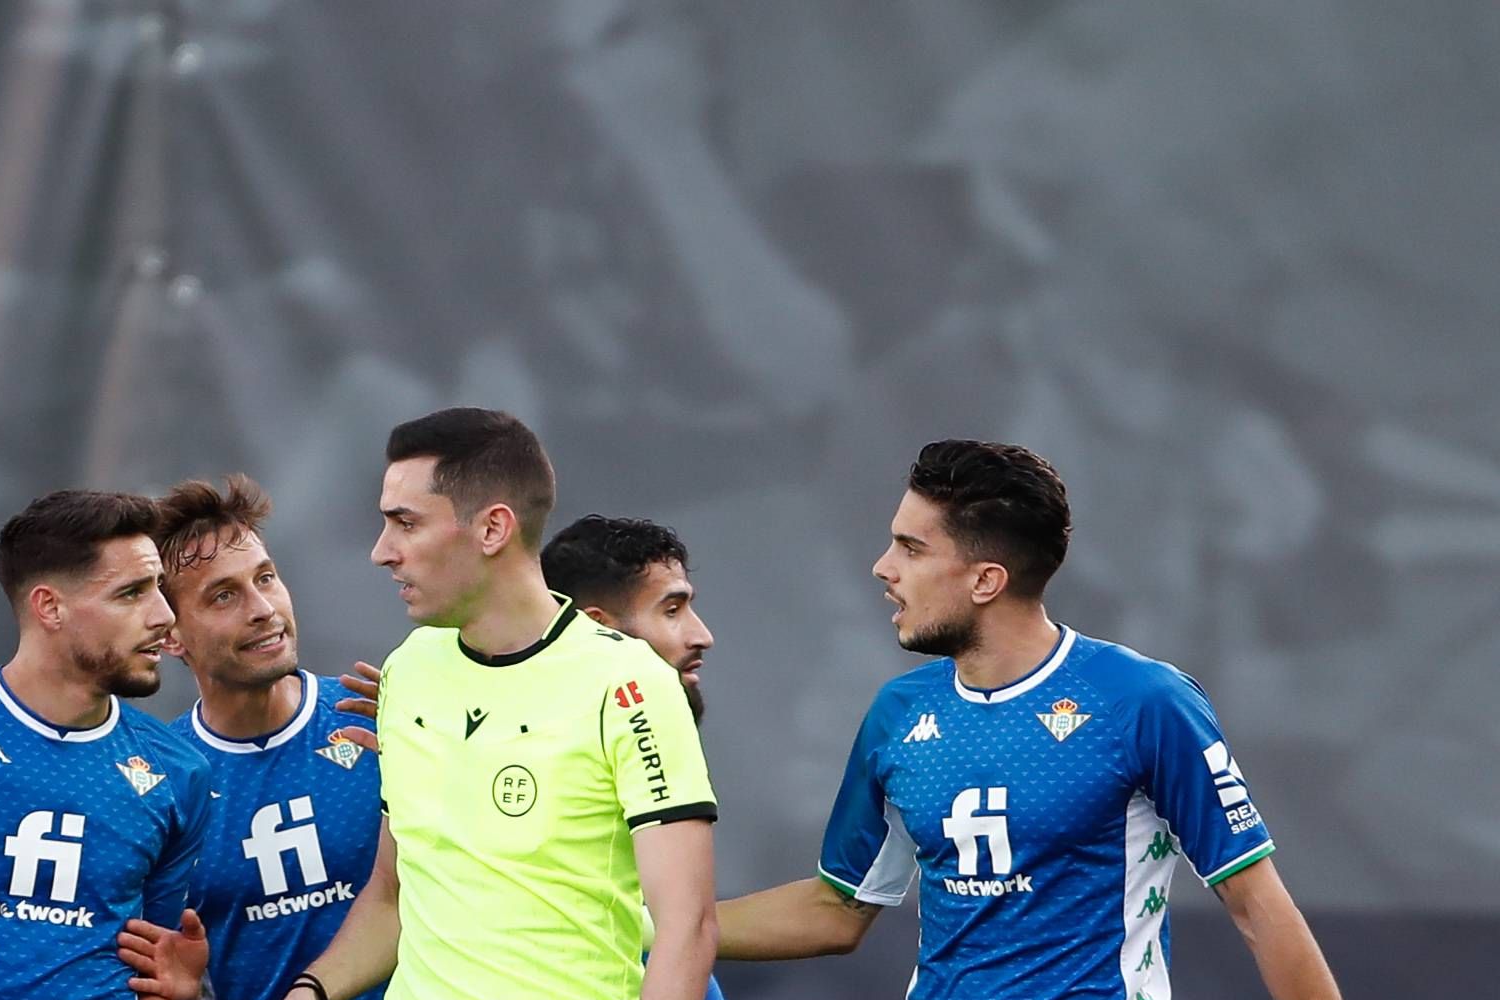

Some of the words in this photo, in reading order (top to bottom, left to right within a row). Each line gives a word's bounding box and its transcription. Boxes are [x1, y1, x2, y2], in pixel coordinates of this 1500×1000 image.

[629, 710, 671, 803] WÜRTH
[244, 880, 356, 922] network
[944, 874, 1033, 898] network
